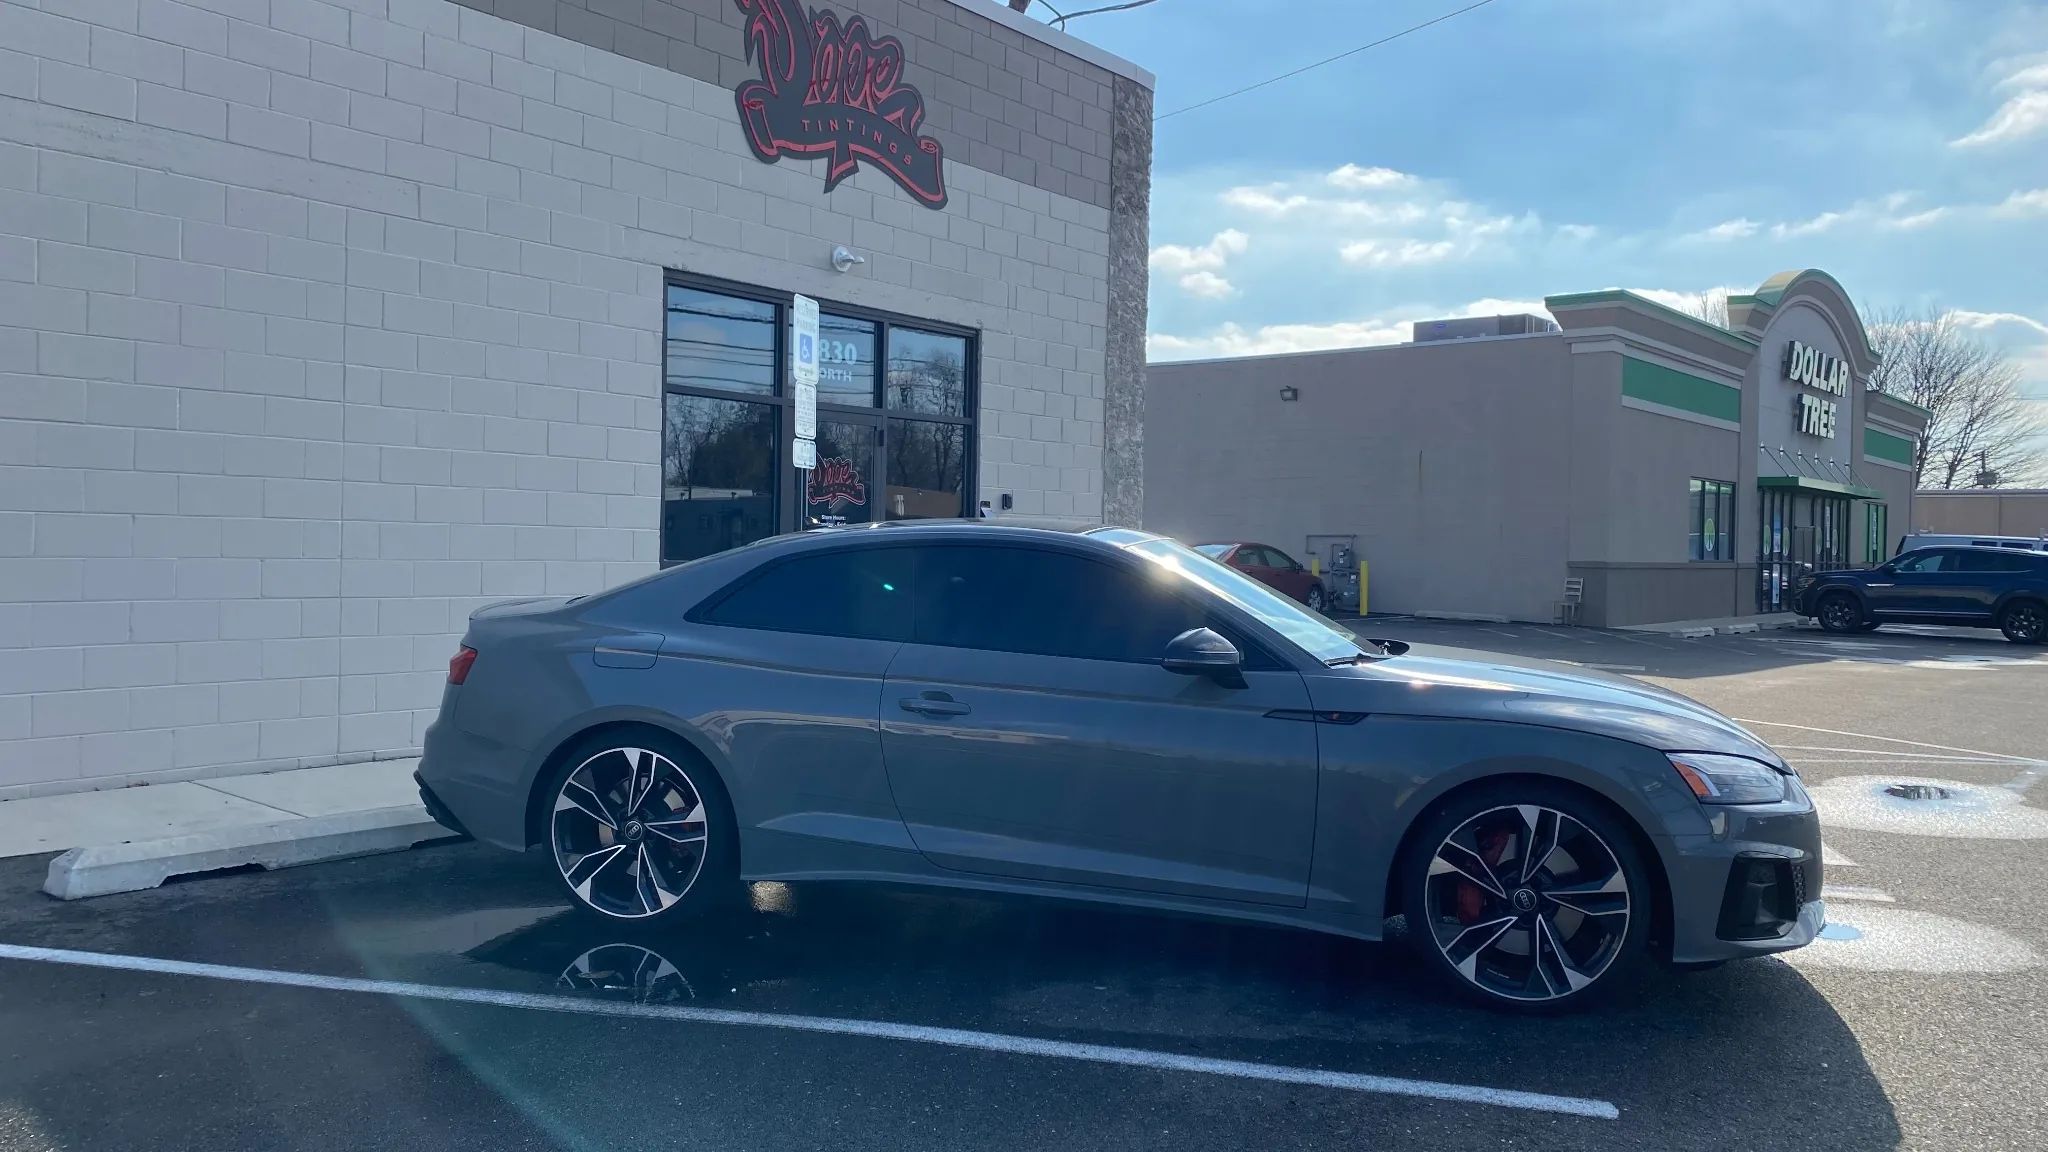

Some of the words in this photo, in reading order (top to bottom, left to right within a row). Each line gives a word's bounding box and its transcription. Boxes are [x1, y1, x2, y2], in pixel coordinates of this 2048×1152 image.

[802, 119, 912, 165] TINTINGS
[818, 367, 852, 382] ORTH
[1790, 340, 1849, 397] DOLLAR
[1800, 395, 1837, 440] TREE
